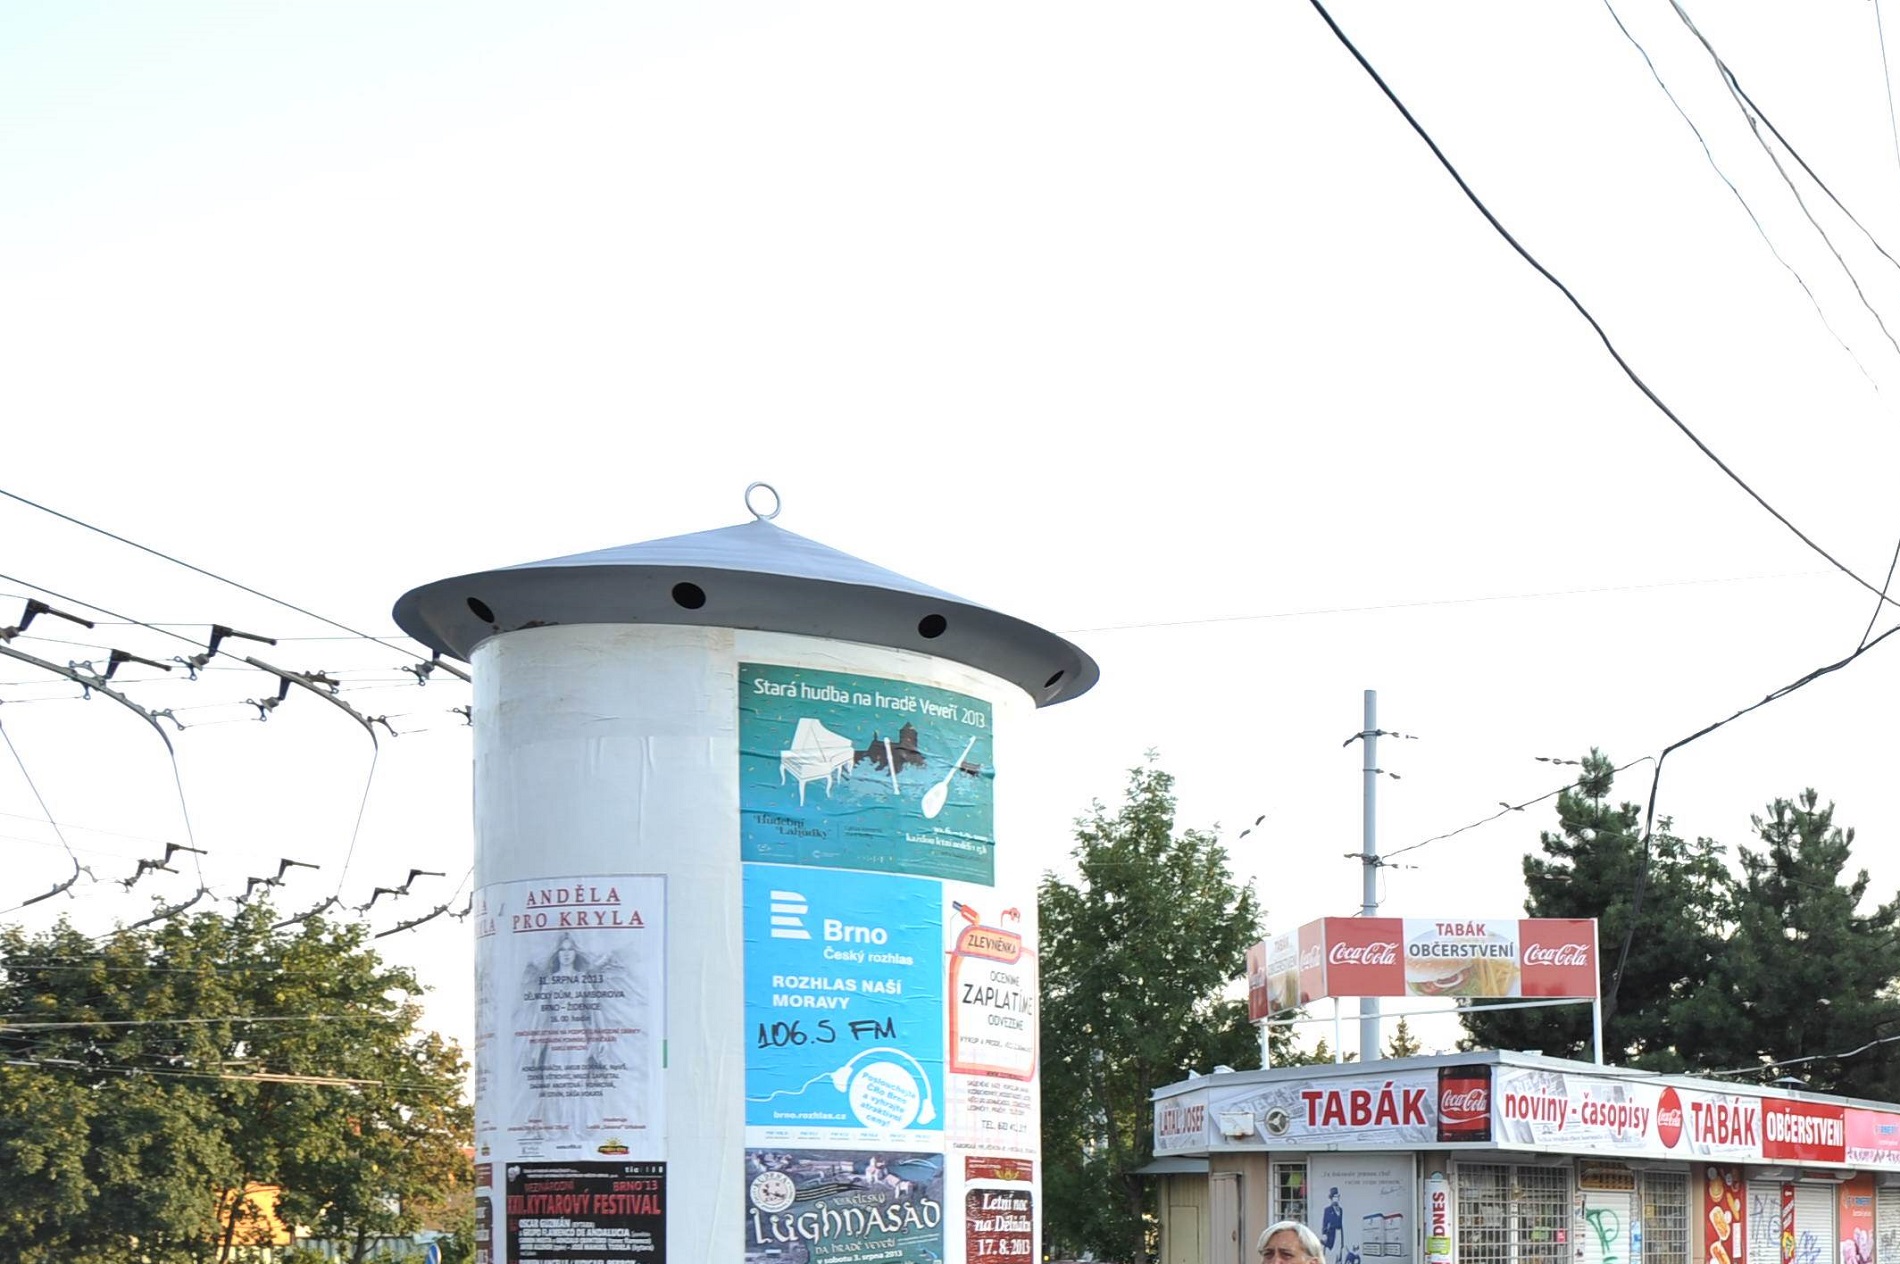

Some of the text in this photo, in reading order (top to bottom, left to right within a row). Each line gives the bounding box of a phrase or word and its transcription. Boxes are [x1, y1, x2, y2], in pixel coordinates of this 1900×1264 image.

[753, 678, 986, 728] Stará hudba na hradě Veveří 2013
[527, 884, 621, 906] ANDĚLA
[512, 910, 644, 930] PRO KRYLA
[823, 918, 889, 945] Brno
[967, 934, 1017, 954] ZLEVNĚNKA
[1329, 923, 1589, 967] Coca-Cola TABÁK Coca-Cola
[1409, 940, 1515, 958] OBČERSTVENÍ
[823, 946, 914, 966] Český rozhlas
[551, 975, 579, 985] SRPNA
[581, 974, 604, 984] 2013
[772, 975, 903, 995] ROZHLAS NAŠÍ
[772, 994, 851, 1010] MORAVY
[962, 983, 1033, 1016] ZAPLATÍME
[757, 1016, 897, 1049] 106.5 FM
[1301, 1081, 1428, 1127] TABÁK
[1440, 1088, 1487, 1112] Coca-Cola
[773, 1110, 847, 1121] brno.rozhlas.cz
[1183, 1105, 1204, 1133] JOSEF
[1505, 1087, 1568, 1131] noviny
[1581, 1092, 1650, 1137] časopisy
[1691, 1097, 1756, 1147] TABÁK
[1766, 1108, 1844, 1147] OBČERSTVENÍ
[593, 1194, 662, 1215] FESTIVAL
[982, 1192, 1012, 1211] Letní
[1432, 1191, 1445, 1237] DNES
[977, 1238, 997, 1256] 17.
[998, 1238, 1010, 1255] 8.
[824, 1256, 853, 1264] sobotu
